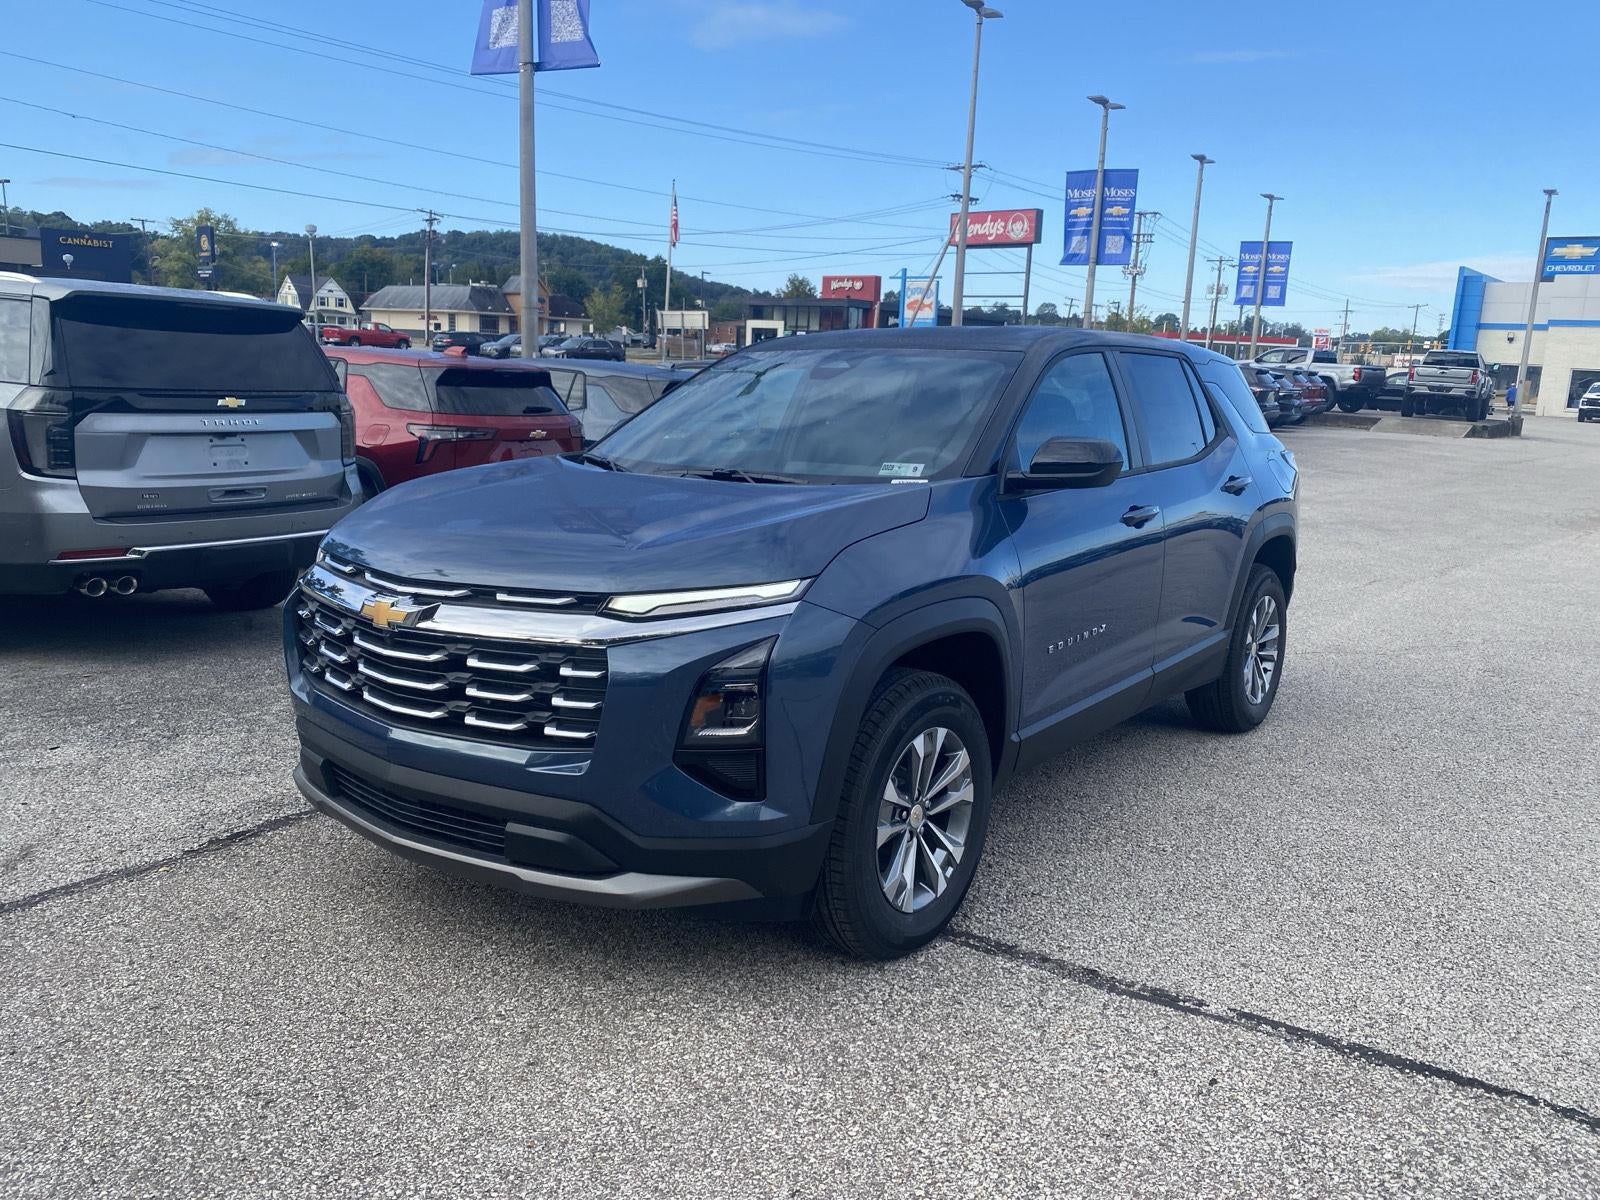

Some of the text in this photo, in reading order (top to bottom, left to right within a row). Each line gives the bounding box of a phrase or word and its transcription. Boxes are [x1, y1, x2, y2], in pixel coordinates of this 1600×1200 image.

[1104, 187, 1136, 197] MOSES
[60, 236, 113, 248] CANNABIST
[1546, 264, 1596, 272] CHEVROLET
[201, 418, 264, 426] TAHOE
[1048, 623, 1107, 654] EQUINOX
